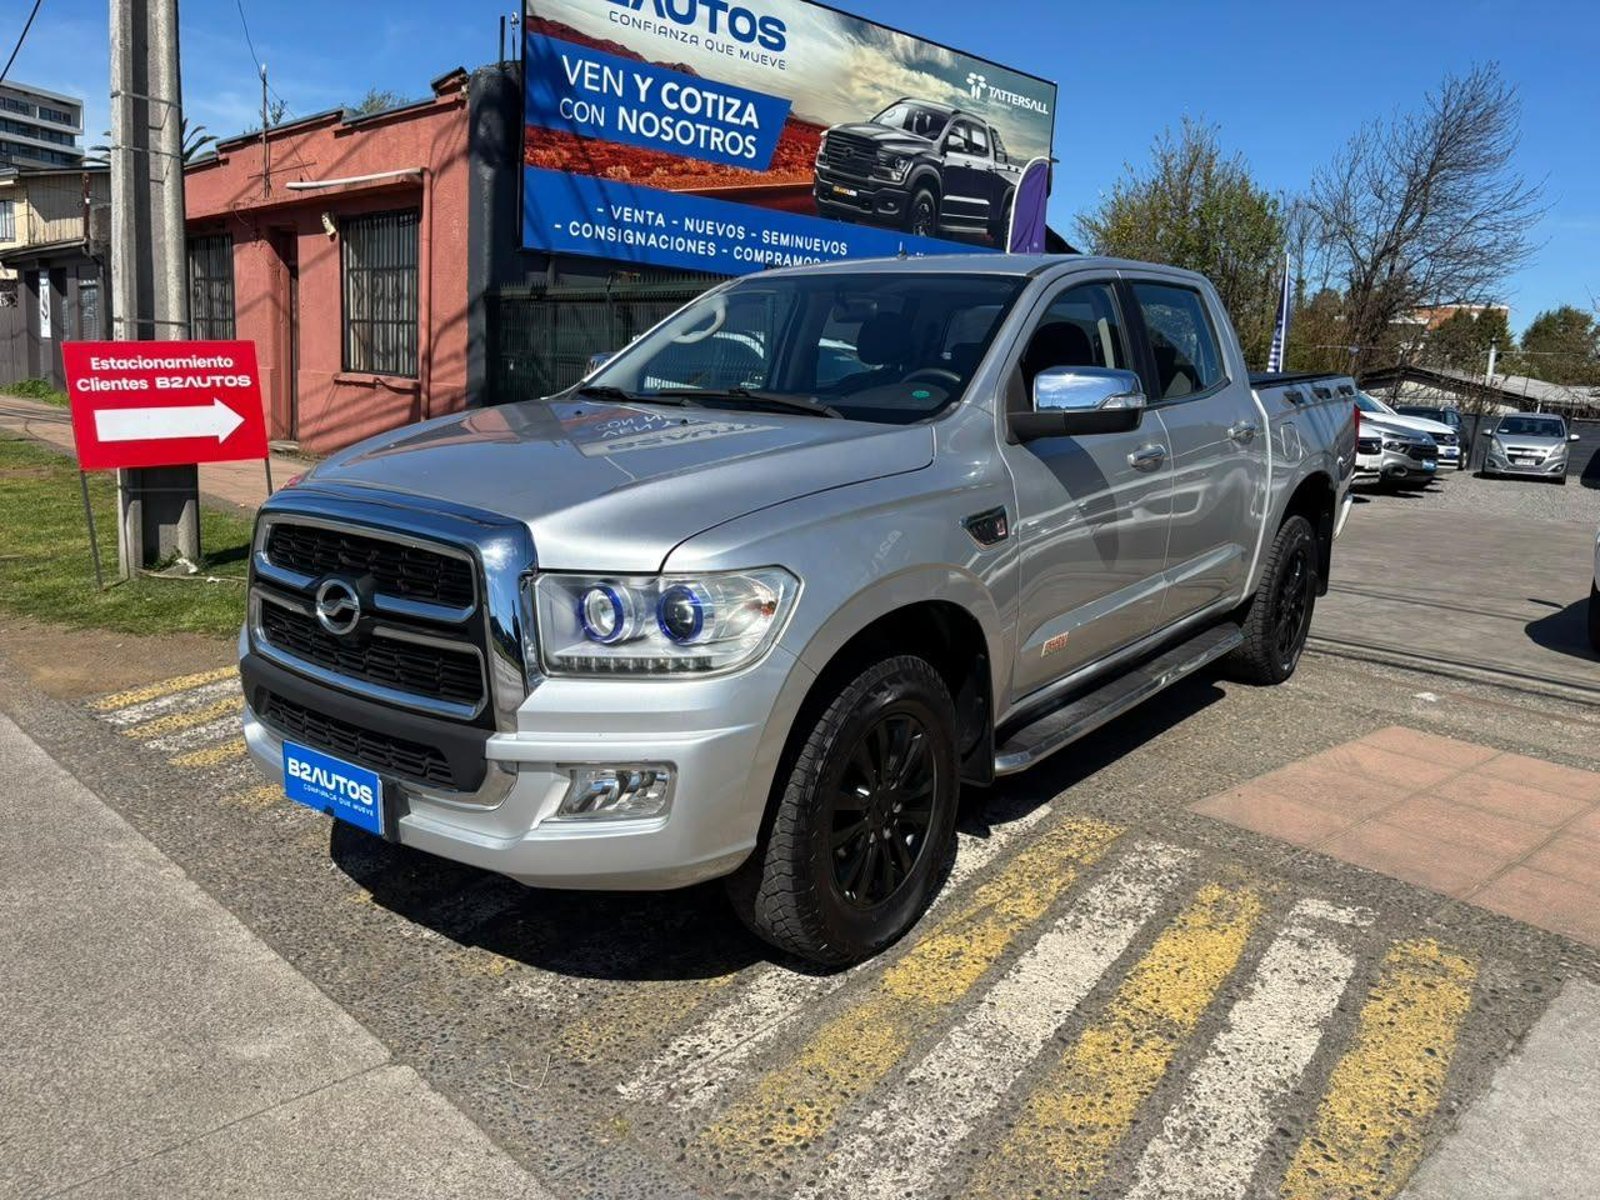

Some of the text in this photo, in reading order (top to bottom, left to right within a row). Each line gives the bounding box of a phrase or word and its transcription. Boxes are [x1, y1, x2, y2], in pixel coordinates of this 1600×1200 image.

[606, 0, 787, 51] UTOS
[609, 10, 786, 70] CONFIANZA QUE MUEVE
[562, 55, 759, 129] VEN Y COTIZA
[988, 86, 1049, 115] TATTERSALL
[559, 97, 757, 159] CON NOSOTROS
[569, 220, 716, 256] CONSIGNACIONES
[611, 205, 666, 228] VENTA
[684, 217, 745, 240] NUEVOS
[762, 230, 848, 256] SEMINUEVOS
[76, 375, 252, 392] Clientes B2AUTOS
[90, 354, 234, 370] Estacionamiento
[288, 757, 373, 805] B2AUTOS
